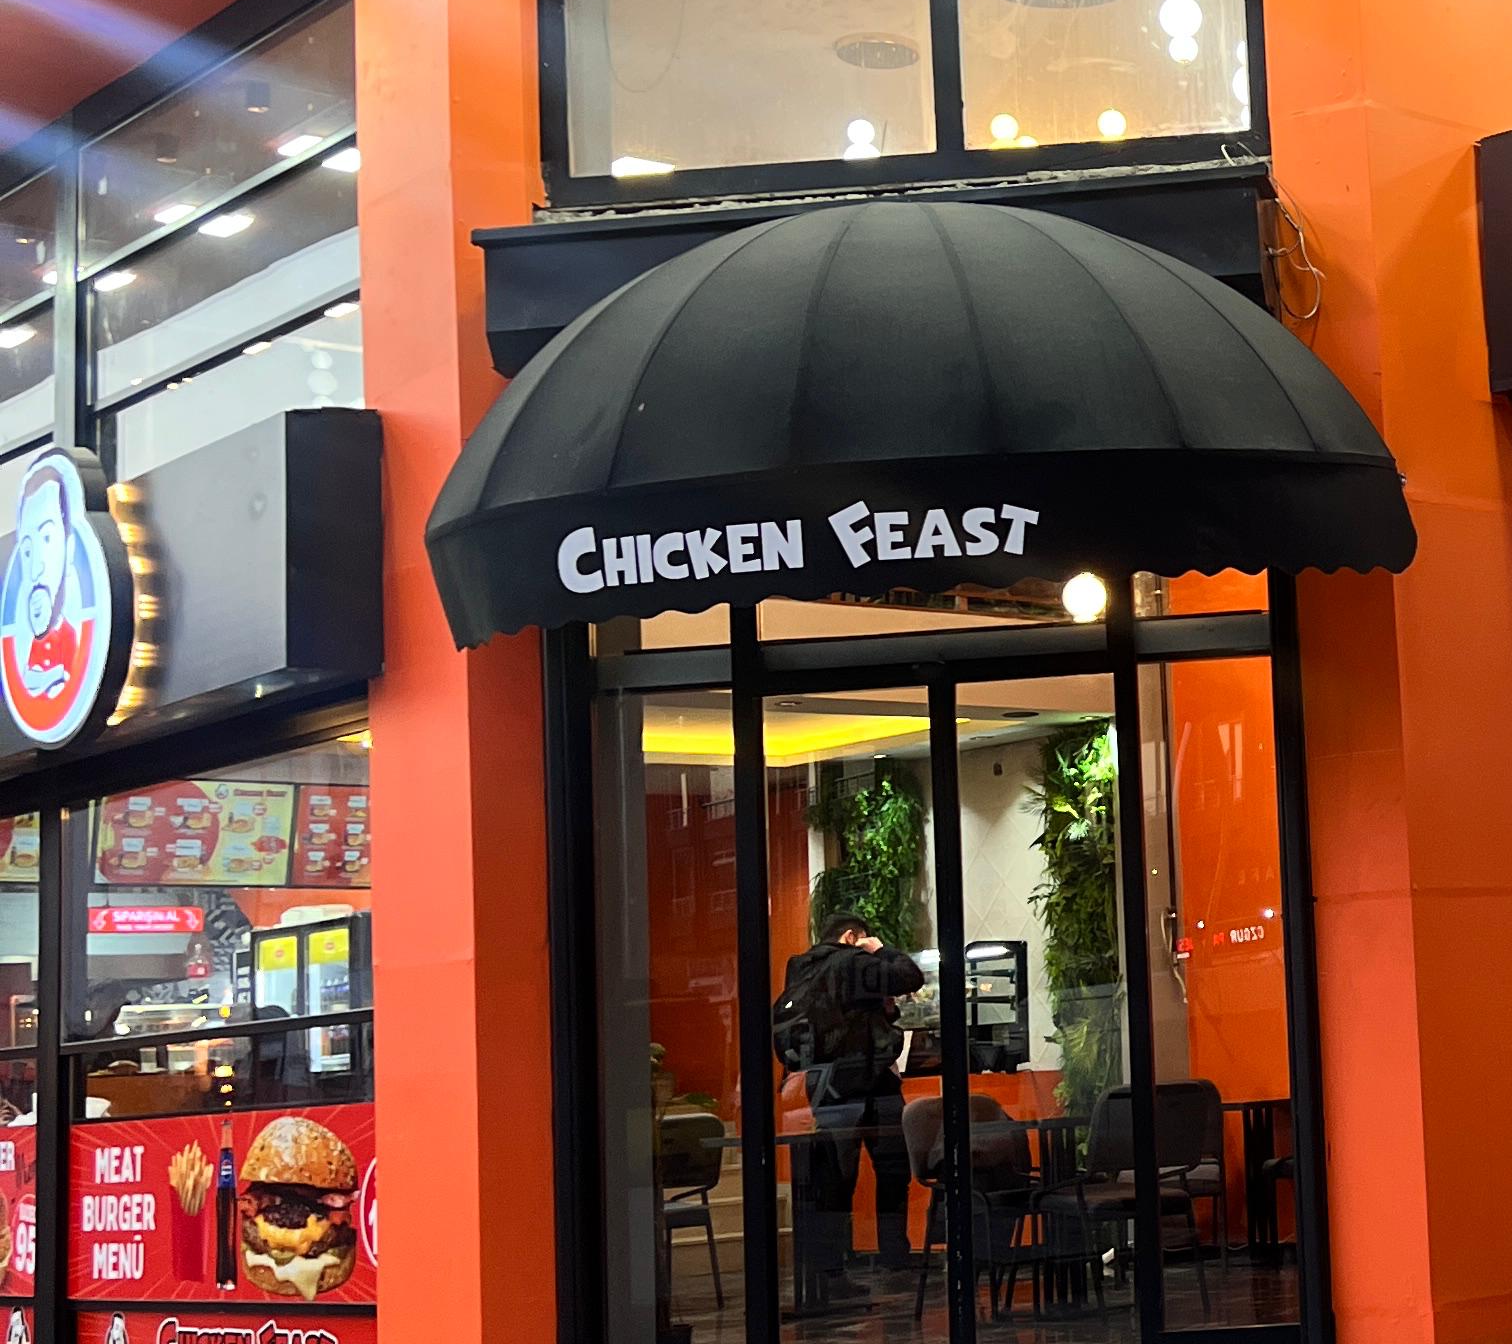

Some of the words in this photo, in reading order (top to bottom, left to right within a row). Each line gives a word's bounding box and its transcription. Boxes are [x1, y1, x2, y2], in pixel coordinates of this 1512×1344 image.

[558, 520, 804, 594] CHICKEN
[828, 501, 1039, 569] FEAST
[95, 1146, 144, 1185] MEAT
[82, 1193, 156, 1232] BURGER
[92, 1235, 145, 1280] MENÜ
